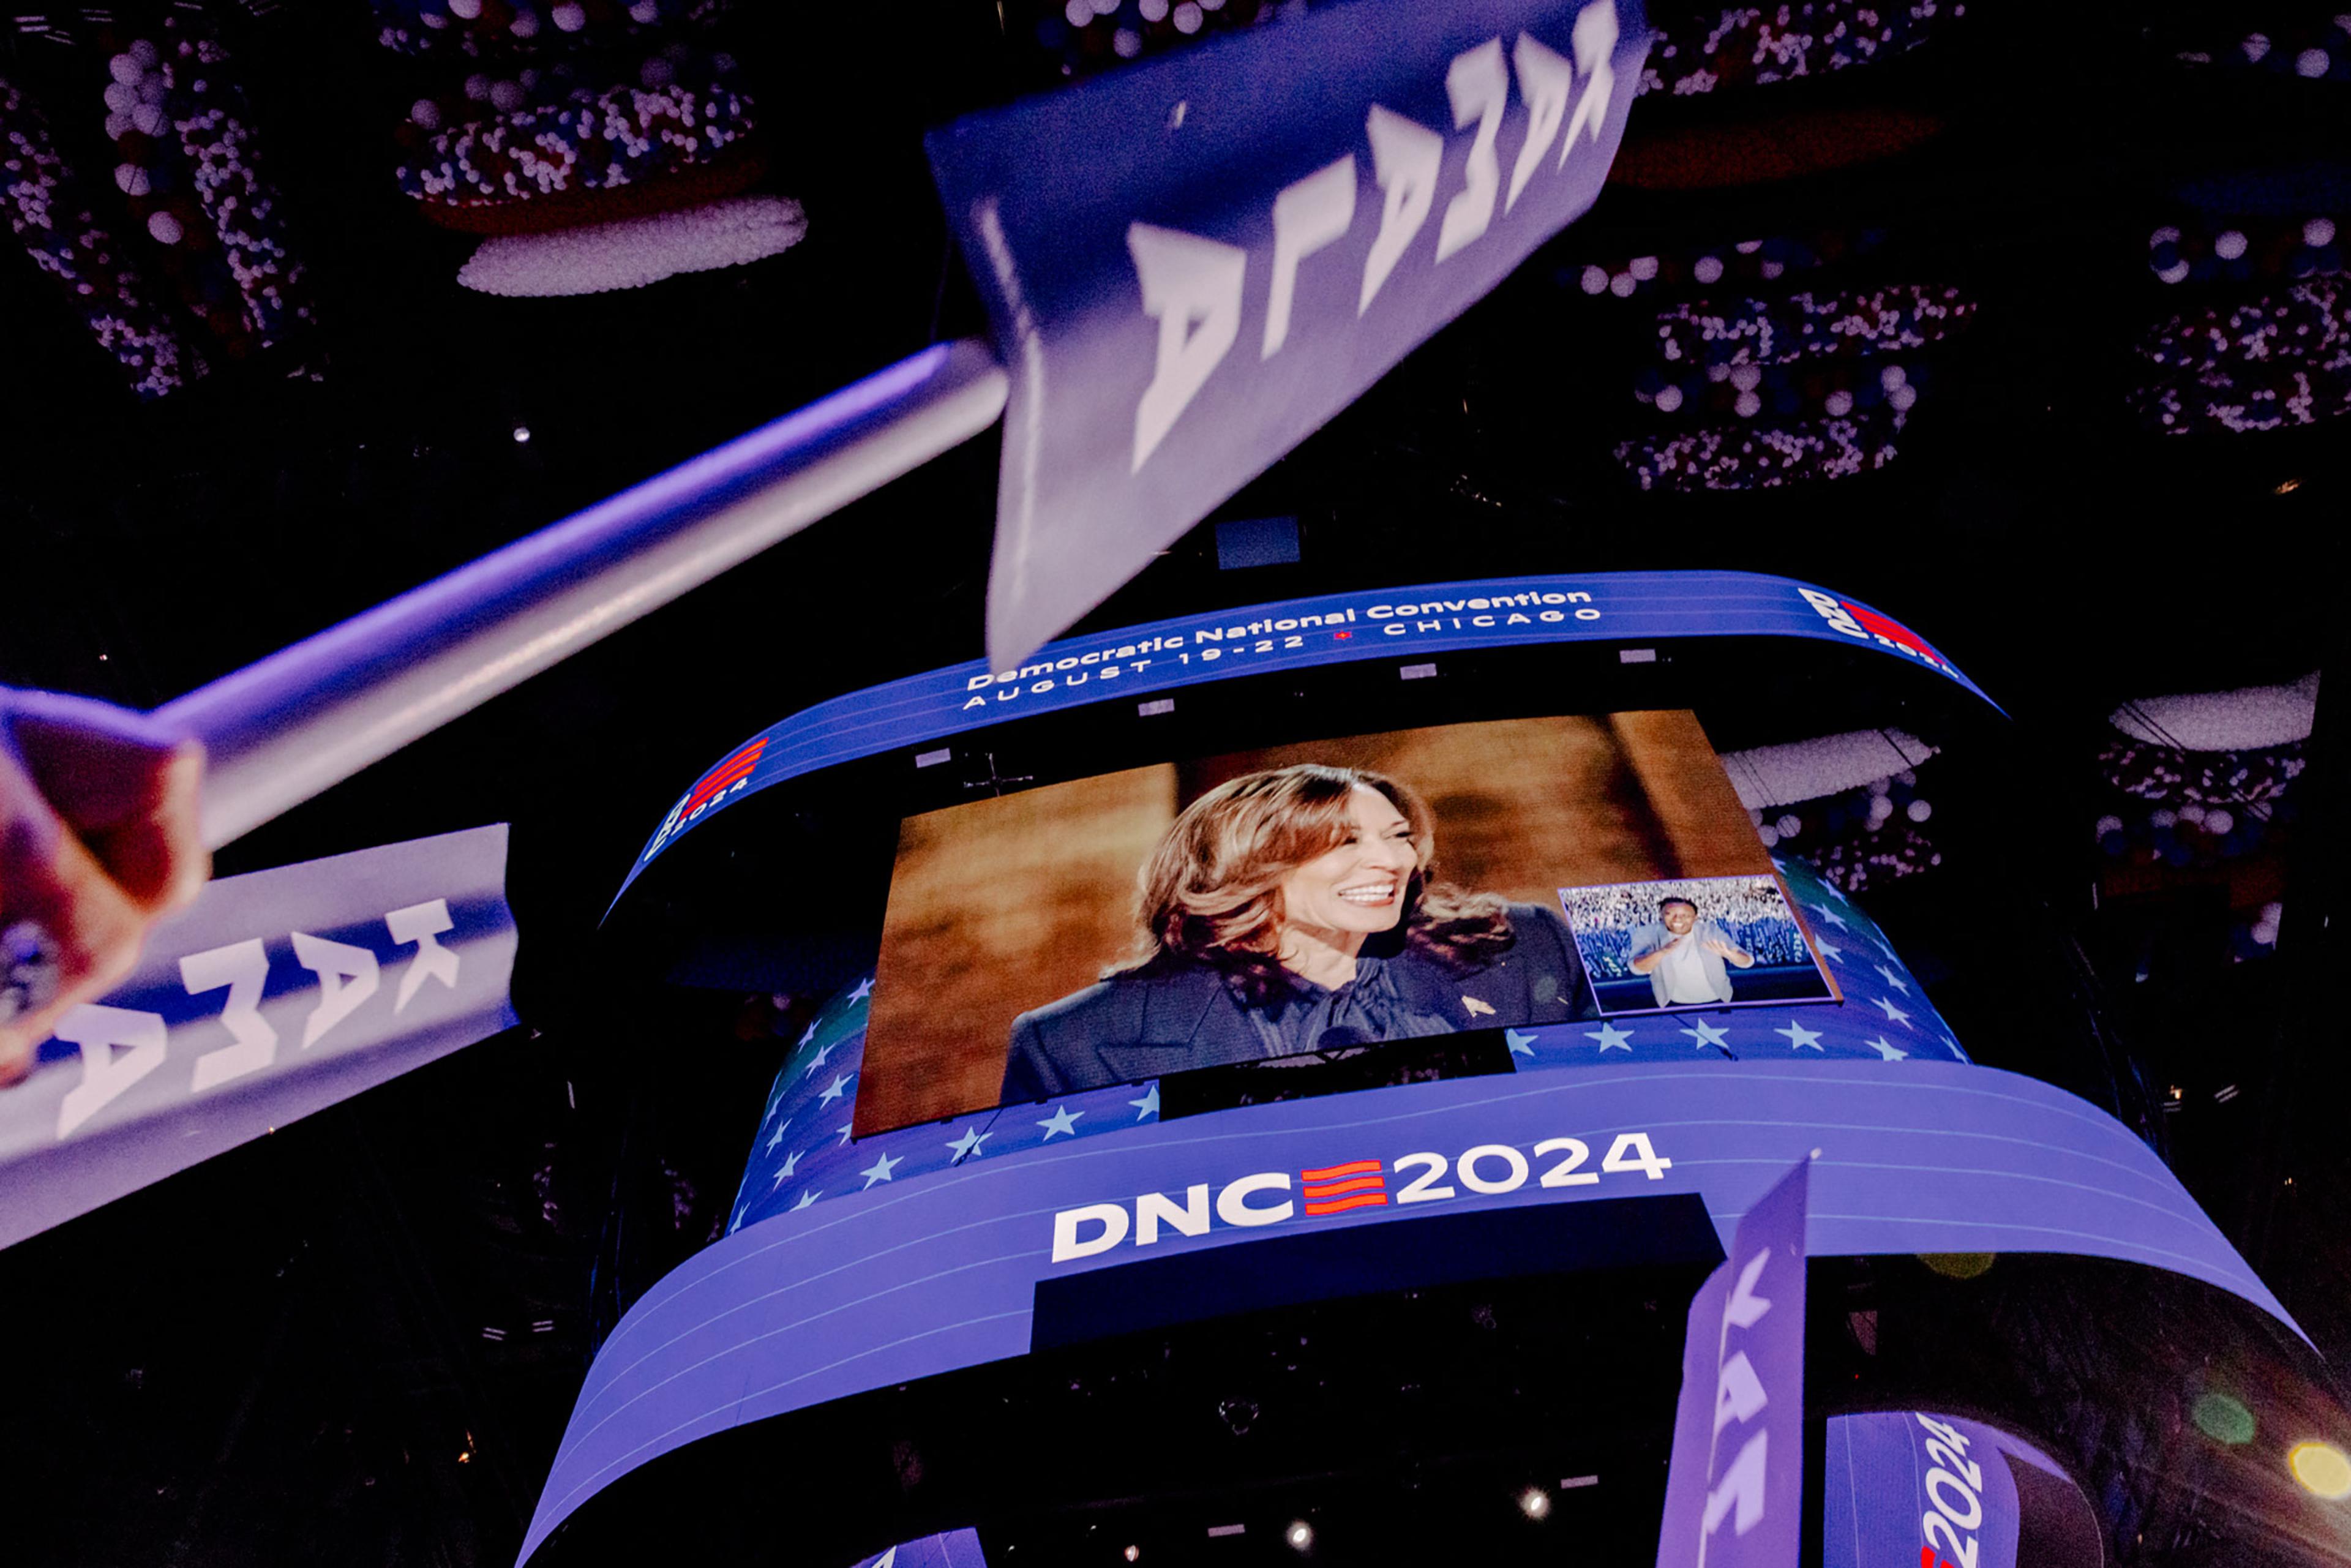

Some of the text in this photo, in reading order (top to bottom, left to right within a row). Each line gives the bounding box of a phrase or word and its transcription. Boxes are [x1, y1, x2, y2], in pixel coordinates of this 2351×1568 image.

[1126, 0, 1619, 478] KAMALA
[962, 659, 1152, 710] AUGUST
[1384, 609, 1601, 636] CHICAGO
[967, 591, 1592, 691] Democratic National Convention
[53, 898, 460, 1140] KAMA
[1052, 1132, 1672, 1264] DNC 2024
[1914, 1411, 1983, 1568] 2024
